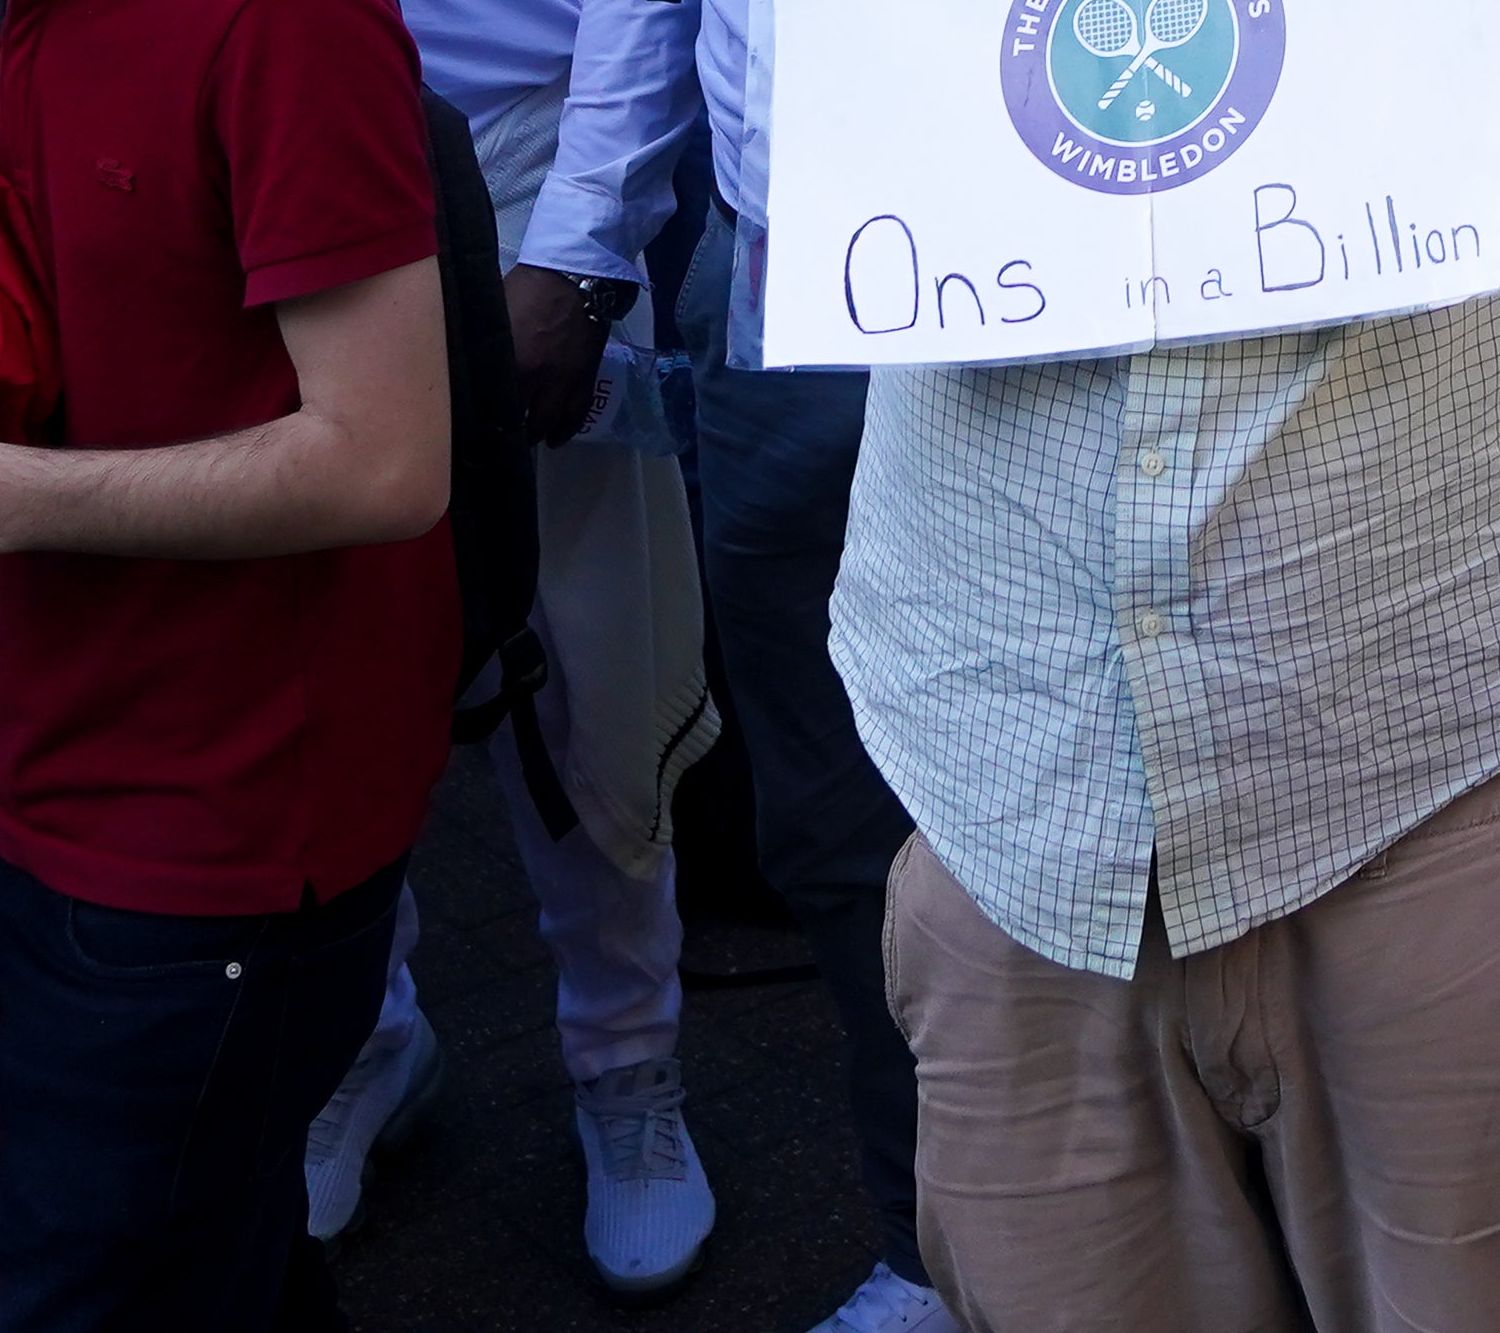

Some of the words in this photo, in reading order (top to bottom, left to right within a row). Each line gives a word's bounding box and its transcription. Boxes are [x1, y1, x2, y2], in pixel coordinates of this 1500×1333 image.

[1050, 107, 1248, 185] WIMBLEDON
[844, 213, 1048, 336] Ons
[1123, 270, 1171, 310] in
[1201, 267, 1233, 301] a
[1253, 183, 1482, 295] Billion
